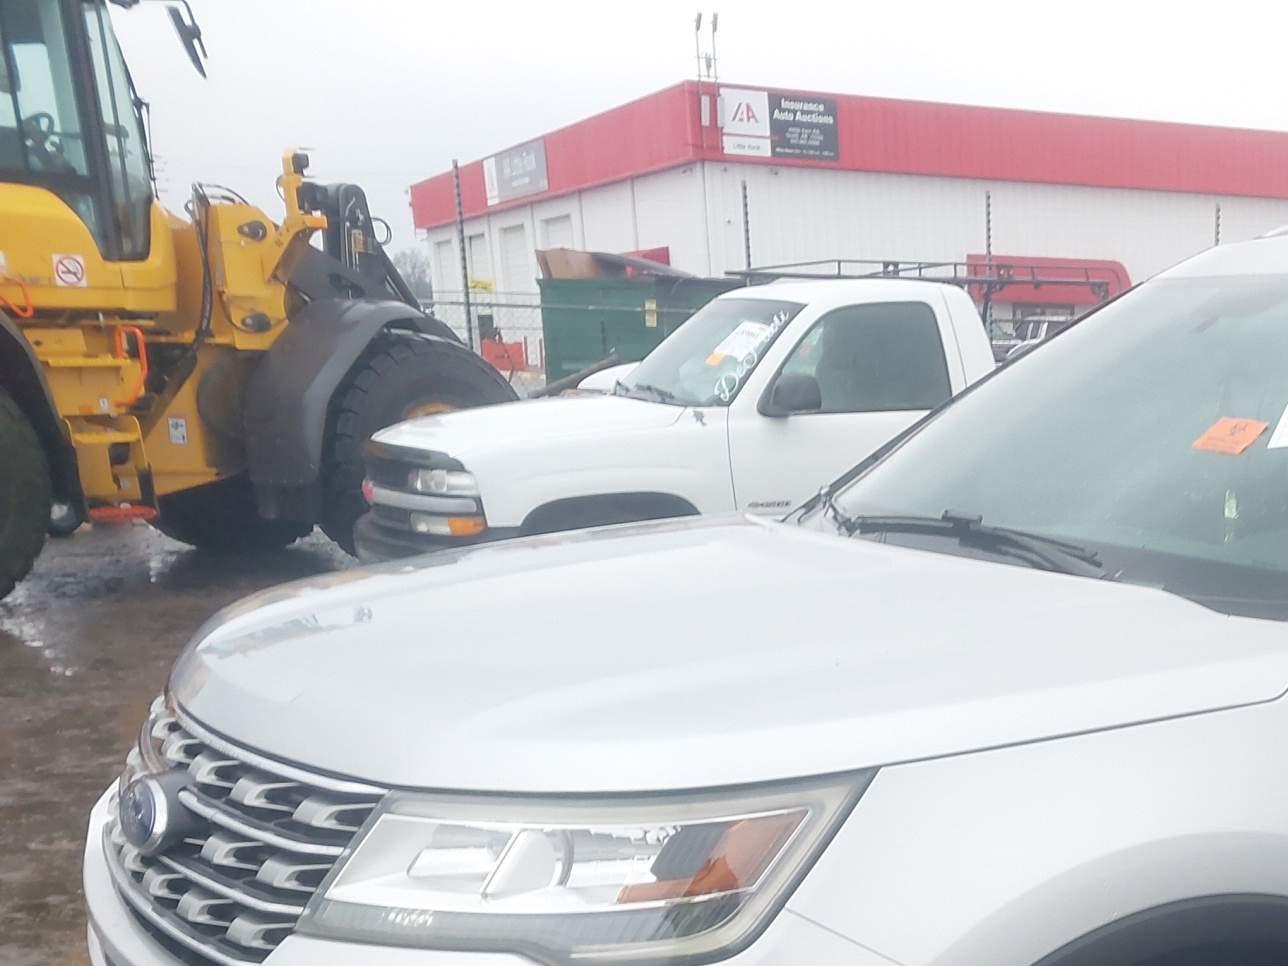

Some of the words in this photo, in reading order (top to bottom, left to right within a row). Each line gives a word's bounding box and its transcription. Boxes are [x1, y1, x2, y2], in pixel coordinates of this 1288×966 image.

[780, 97, 825, 112] Insurance
[773, 107, 794, 121] Auto
[795, 110, 834, 124] Auctions
